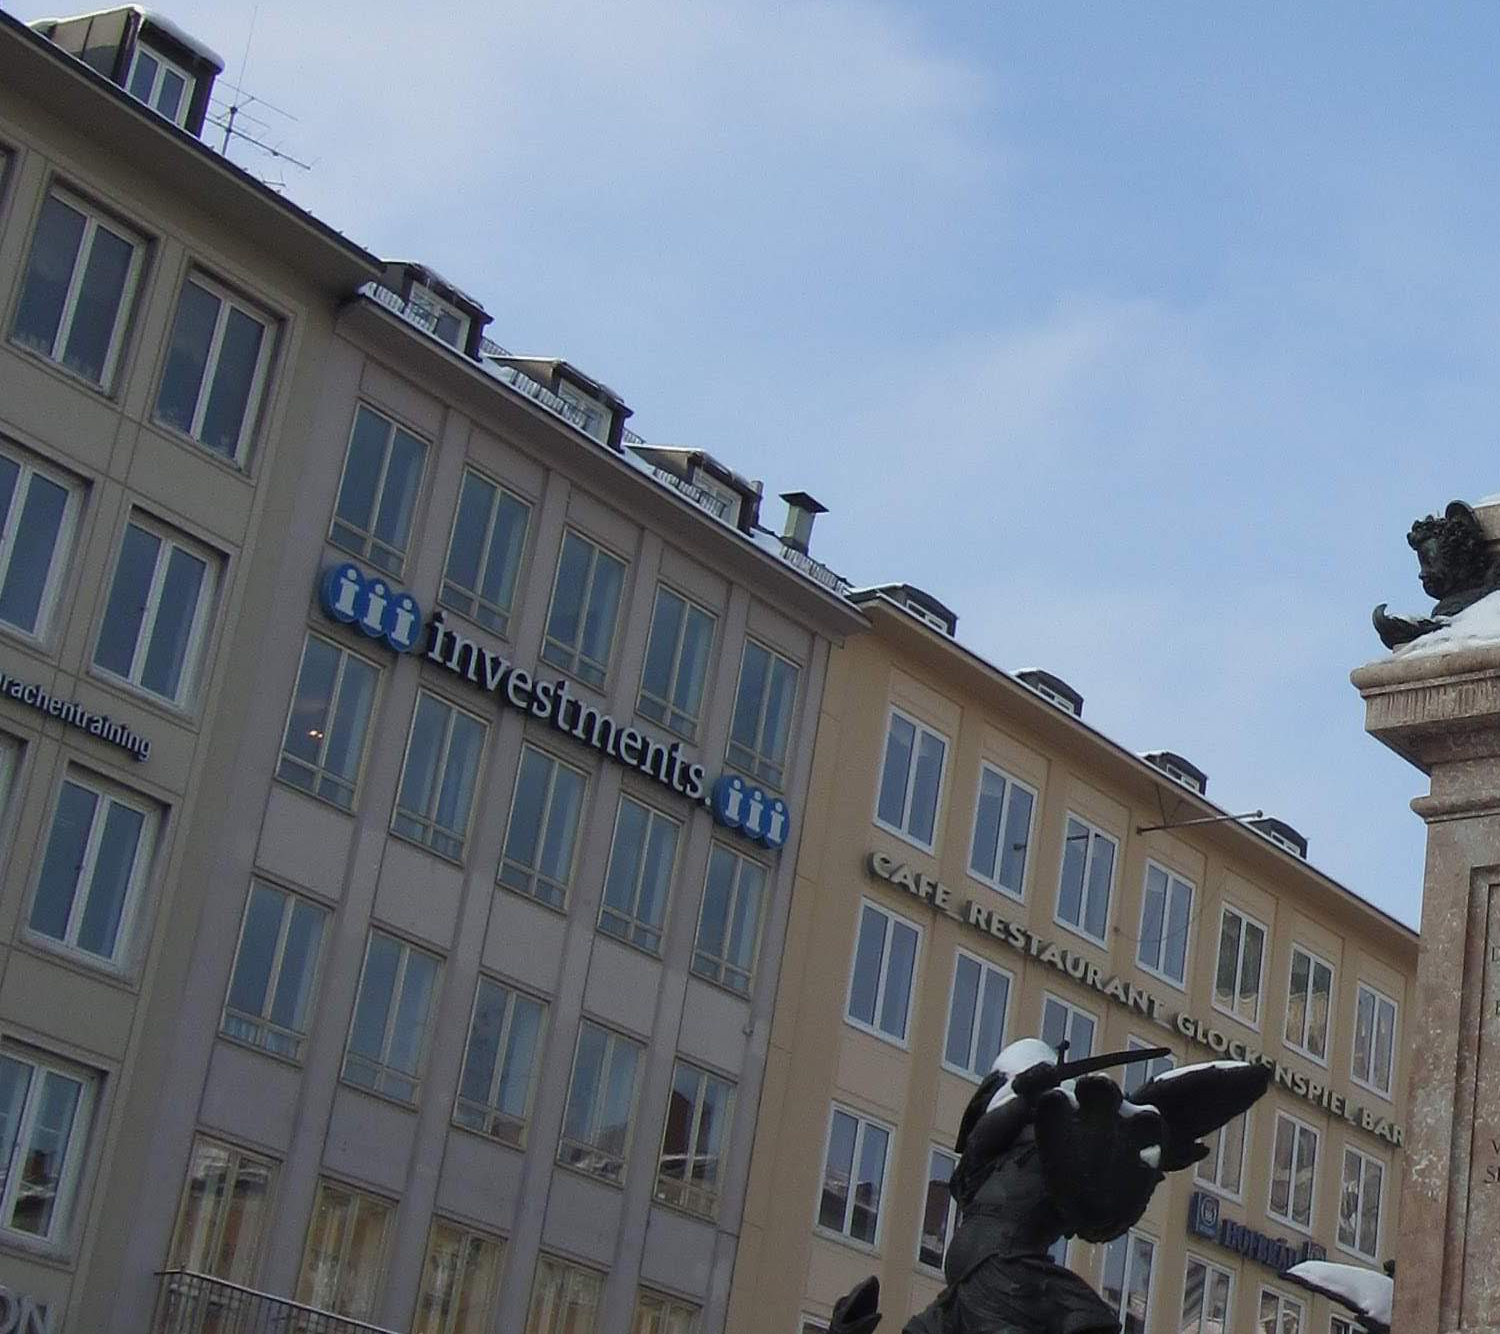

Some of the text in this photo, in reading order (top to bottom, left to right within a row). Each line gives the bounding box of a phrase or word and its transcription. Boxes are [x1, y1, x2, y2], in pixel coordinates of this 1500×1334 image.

[0, 673, 152, 764] rachentraining
[869, 851, 1404, 1147] CAFE RESTAURANT GLOCKENSPIEL BAR
